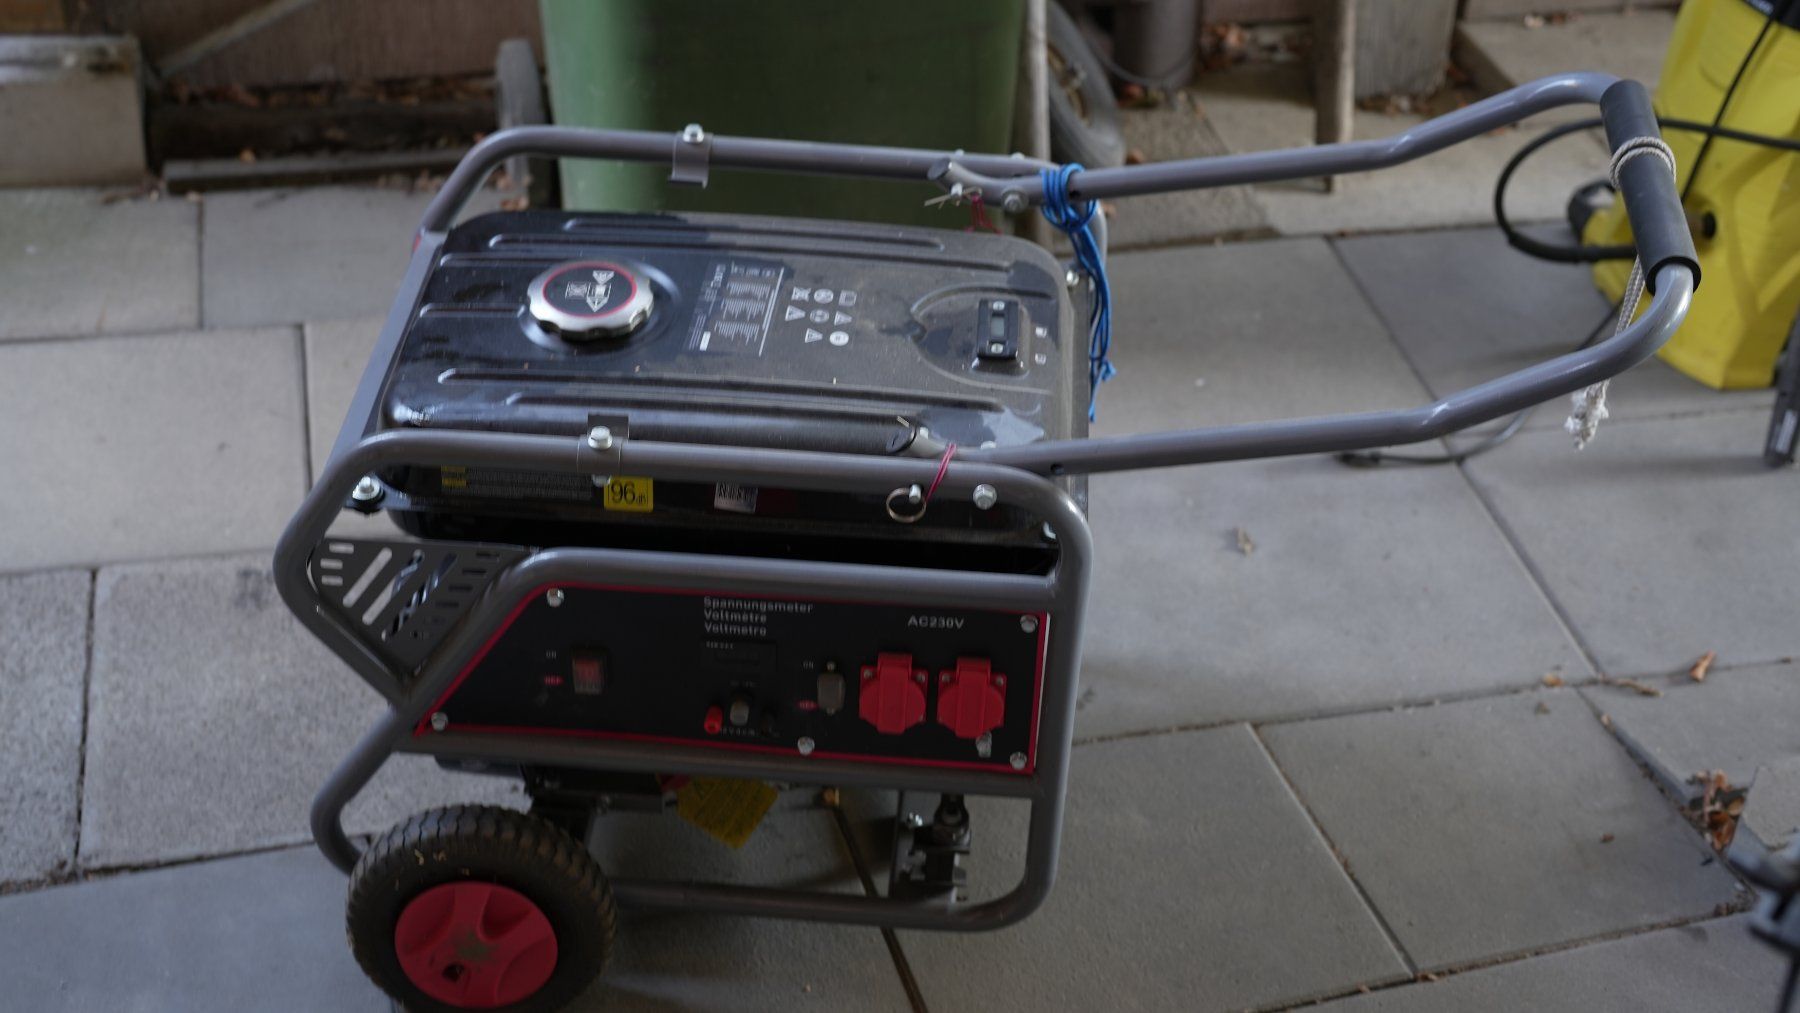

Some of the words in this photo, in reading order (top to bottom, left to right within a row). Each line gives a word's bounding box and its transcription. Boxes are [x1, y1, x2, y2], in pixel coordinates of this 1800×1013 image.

[611, 480, 635, 504] 96
[704, 596, 814, 614] Spannungsmeter
[907, 615, 964, 629] AC230V
